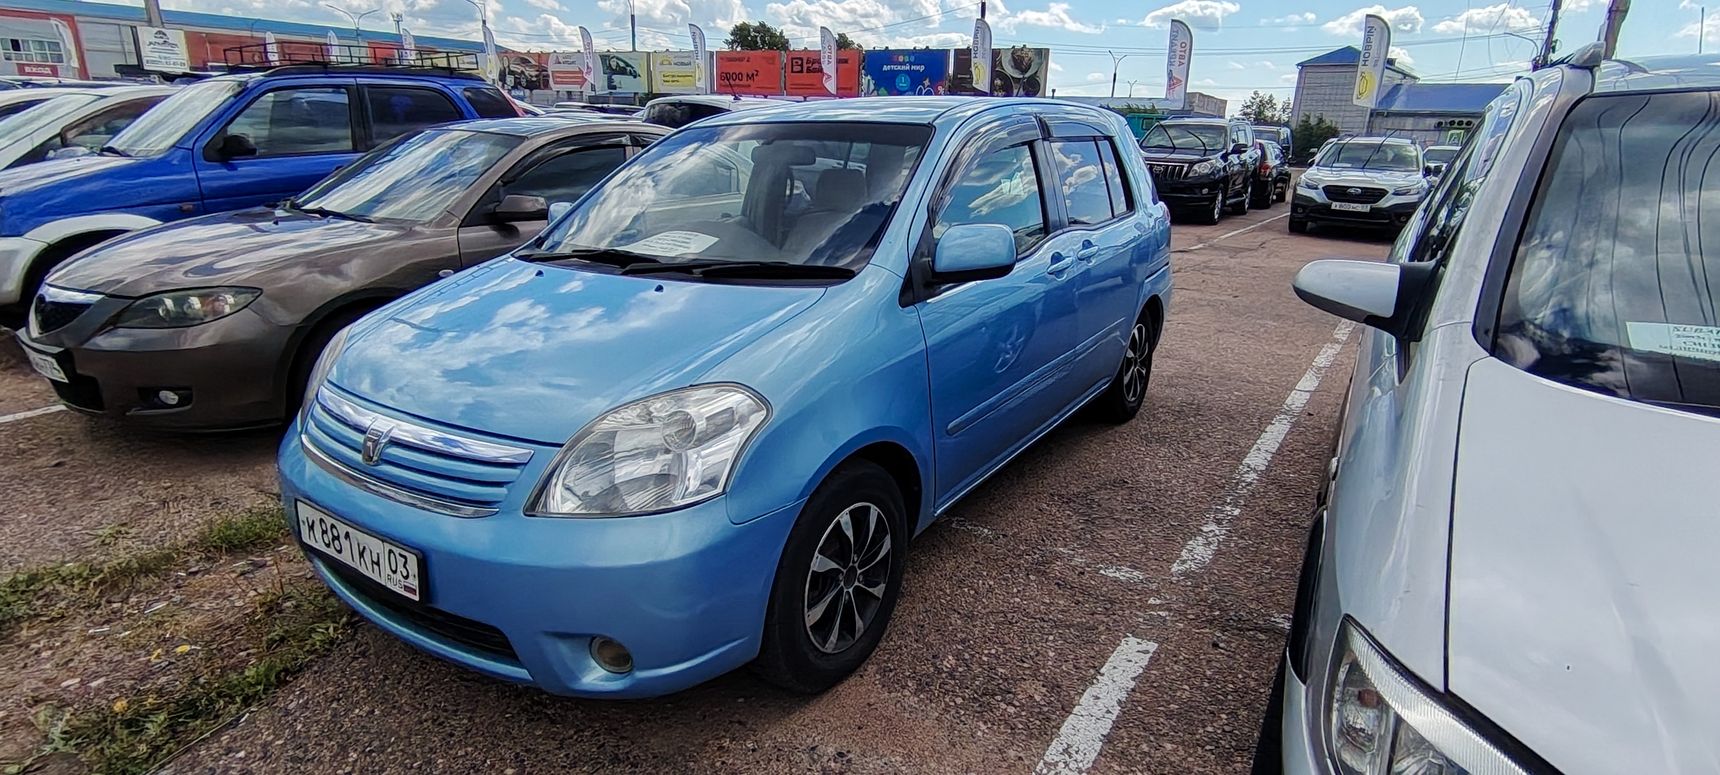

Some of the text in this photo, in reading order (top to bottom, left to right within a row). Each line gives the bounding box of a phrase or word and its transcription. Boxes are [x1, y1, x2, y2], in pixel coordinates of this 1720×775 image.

[882, 63, 925, 73] детский мир
[720, 72, 744, 82] 6000
[306, 516, 410, 580] К881КН 03
[387, 574, 404, 589] RUS
